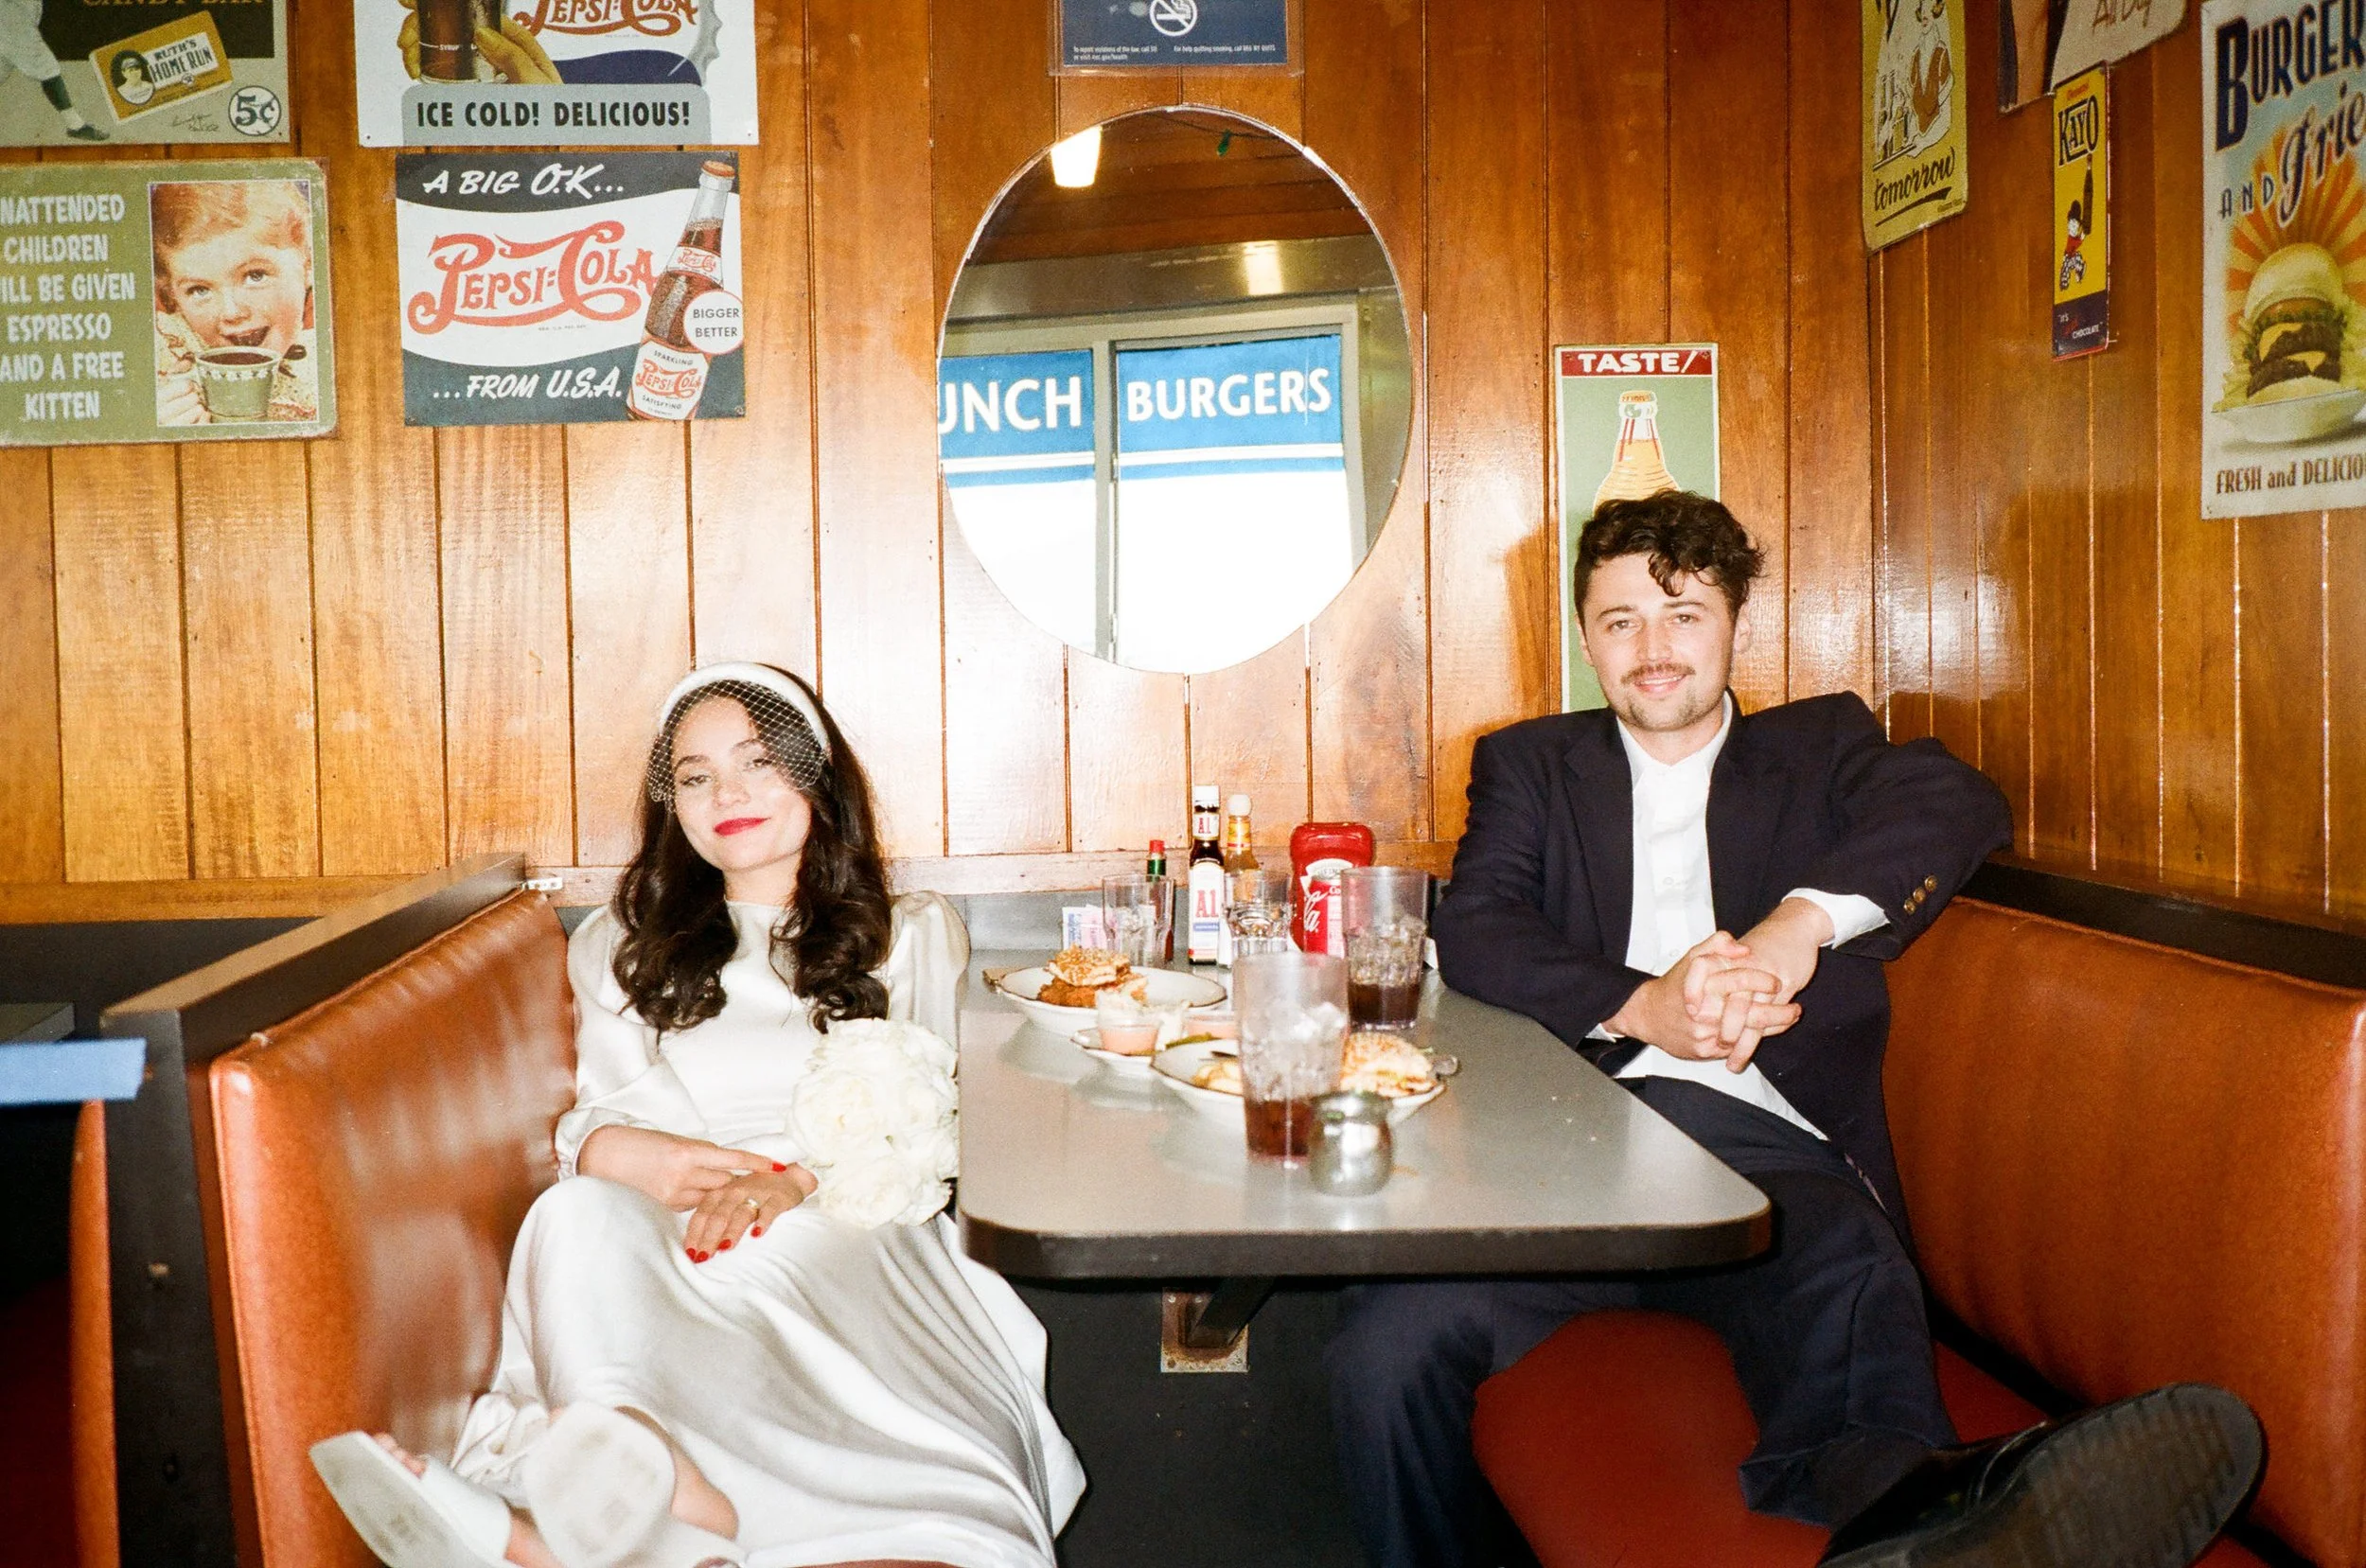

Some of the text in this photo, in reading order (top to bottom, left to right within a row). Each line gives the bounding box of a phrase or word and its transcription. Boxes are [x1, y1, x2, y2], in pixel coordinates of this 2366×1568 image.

[149, 46, 213, 82] HOME RUN
[417, 100, 691, 128] ICE COLD! DELICIOUS!
[2057, 95, 2099, 167] KAYO
[422, 169, 451, 195] A
[458, 169, 520, 194] BIG
[1874, 145, 1956, 212] tomorrow
[2219, 175, 2275, 220] AND
[3, 233, 109, 264] CHILDREN
[37, 273, 65, 303] BE
[71, 272, 136, 301] GIVEN
[7, 312, 113, 344] ESPRESSO
[692, 307, 740, 319] BIGGER
[695, 326, 738, 339] BETTER
[0, 350, 125, 382] AND A FREE
[653, 349, 694, 366] SPARKLING
[545, 365, 623, 399] U.S.A.
[1126, 367, 1333, 422] BURGERS
[25, 390, 101, 420] KITTEN
[2216, 452, 2366, 495] FRESH and DELICIO
